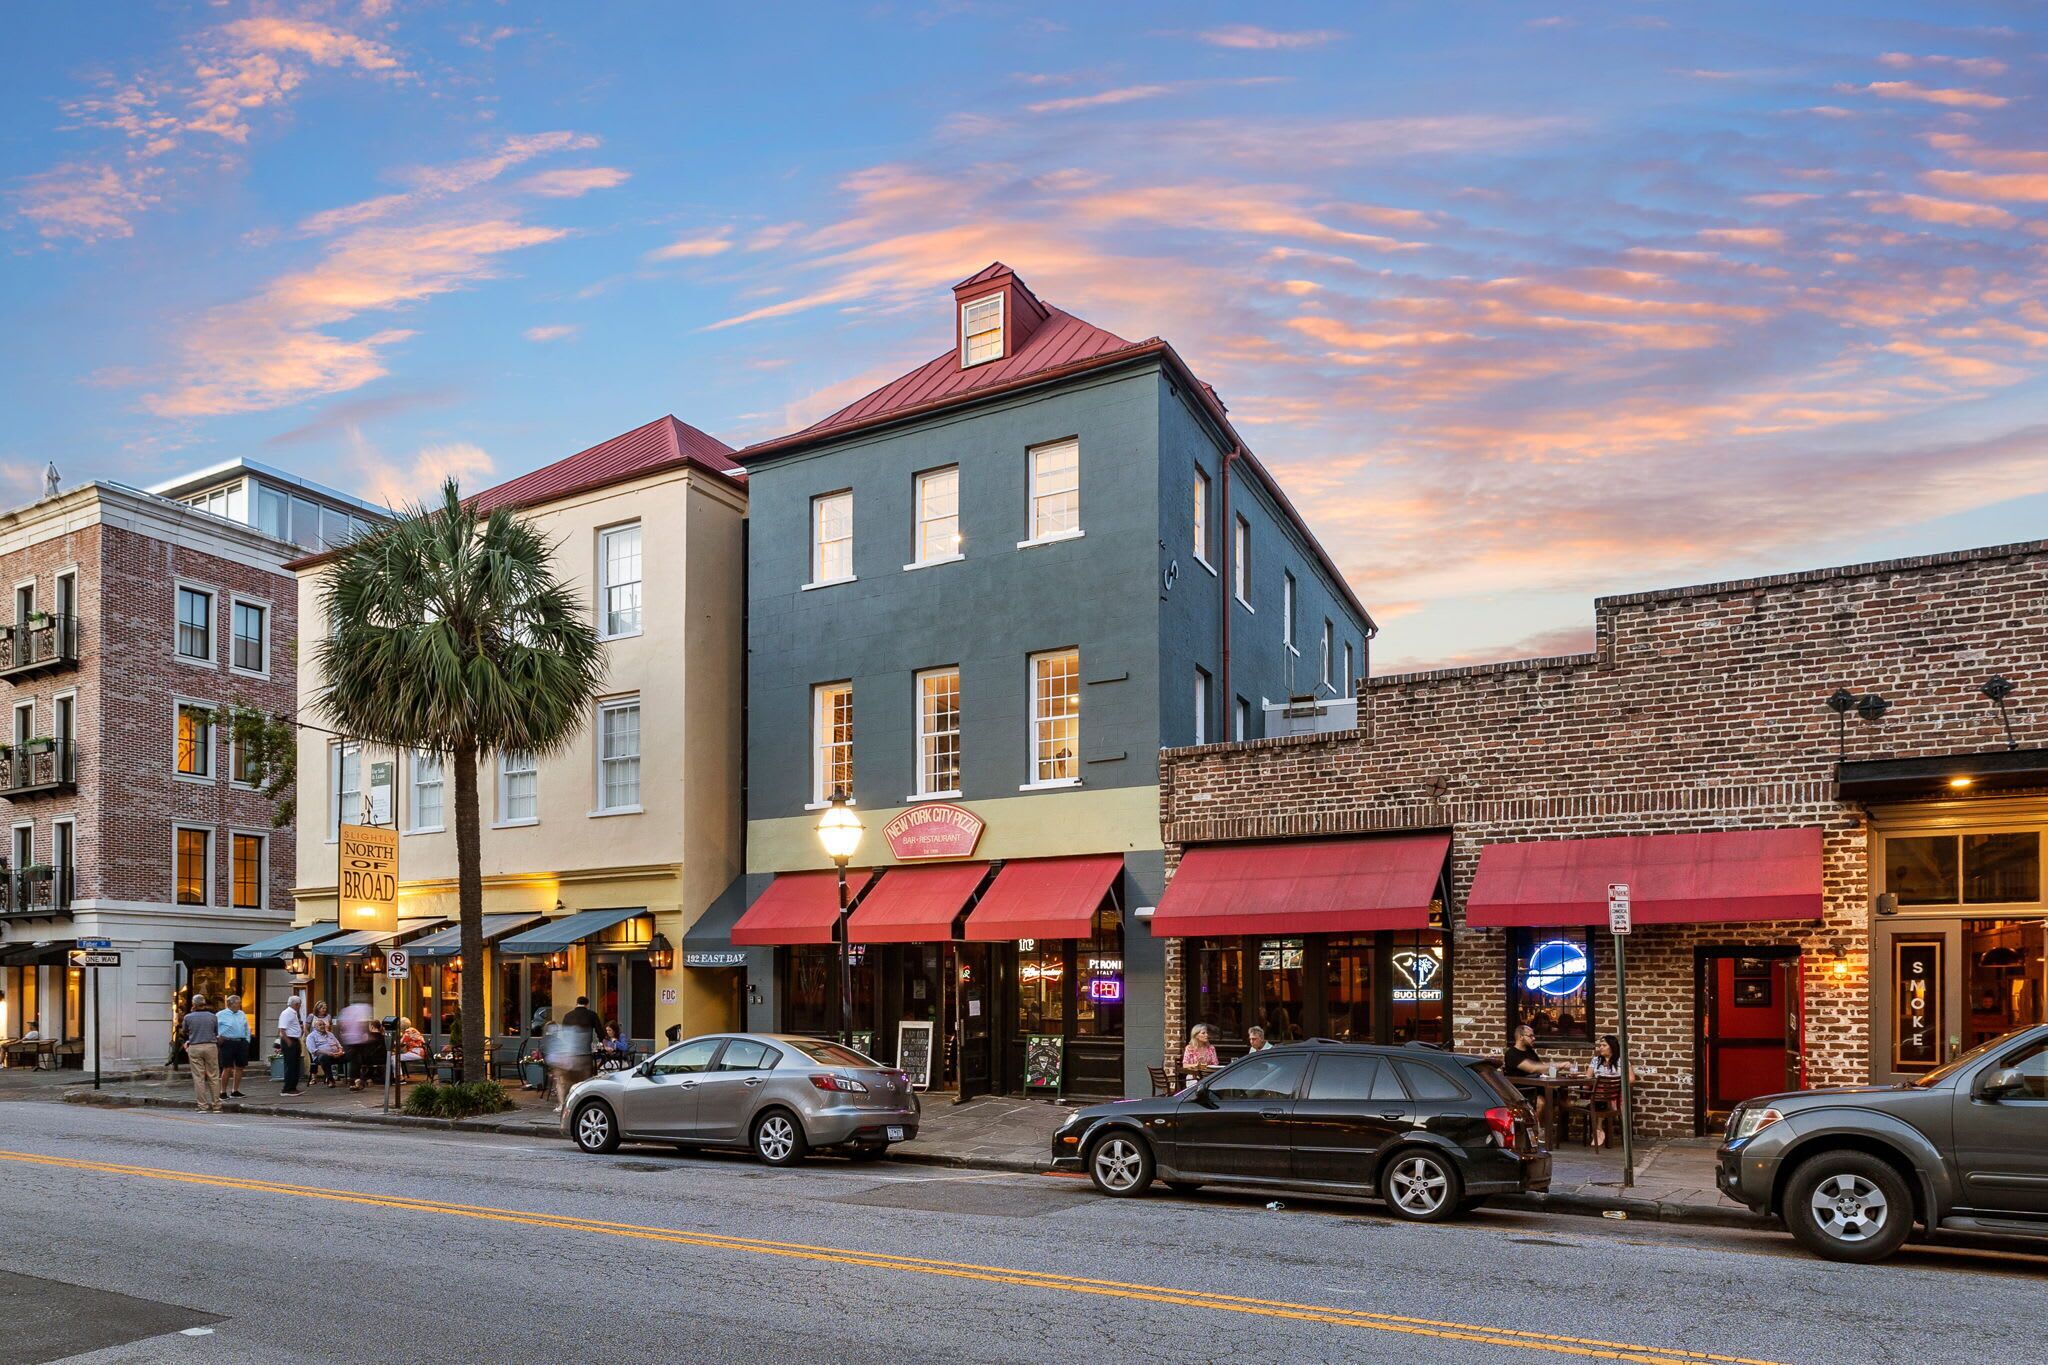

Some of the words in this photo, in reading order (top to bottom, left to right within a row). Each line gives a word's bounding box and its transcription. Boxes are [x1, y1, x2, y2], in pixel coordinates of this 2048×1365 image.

[887, 818, 909, 840] NEW
[907, 808, 933, 827] YORK
[932, 808, 953, 824] CITY
[952, 811, 979, 836] PIZZA
[344, 830, 395, 843] SLIGHTLY
[903, 836, 916, 844] BAR
[919, 834, 960, 844] RESTAURANT
[345, 842, 394, 859] NORTH
[351, 860, 388, 869] OF
[344, 871, 395, 901] BROAD
[687, 954, 700, 962] 192
[701, 954, 724, 963] EAST
[726, 953, 745, 963] BAY
[662, 990, 676, 999] FDC
[1093, 982, 1116, 997] OPEN
[1910, 961, 1926, 1046] SMOKE
